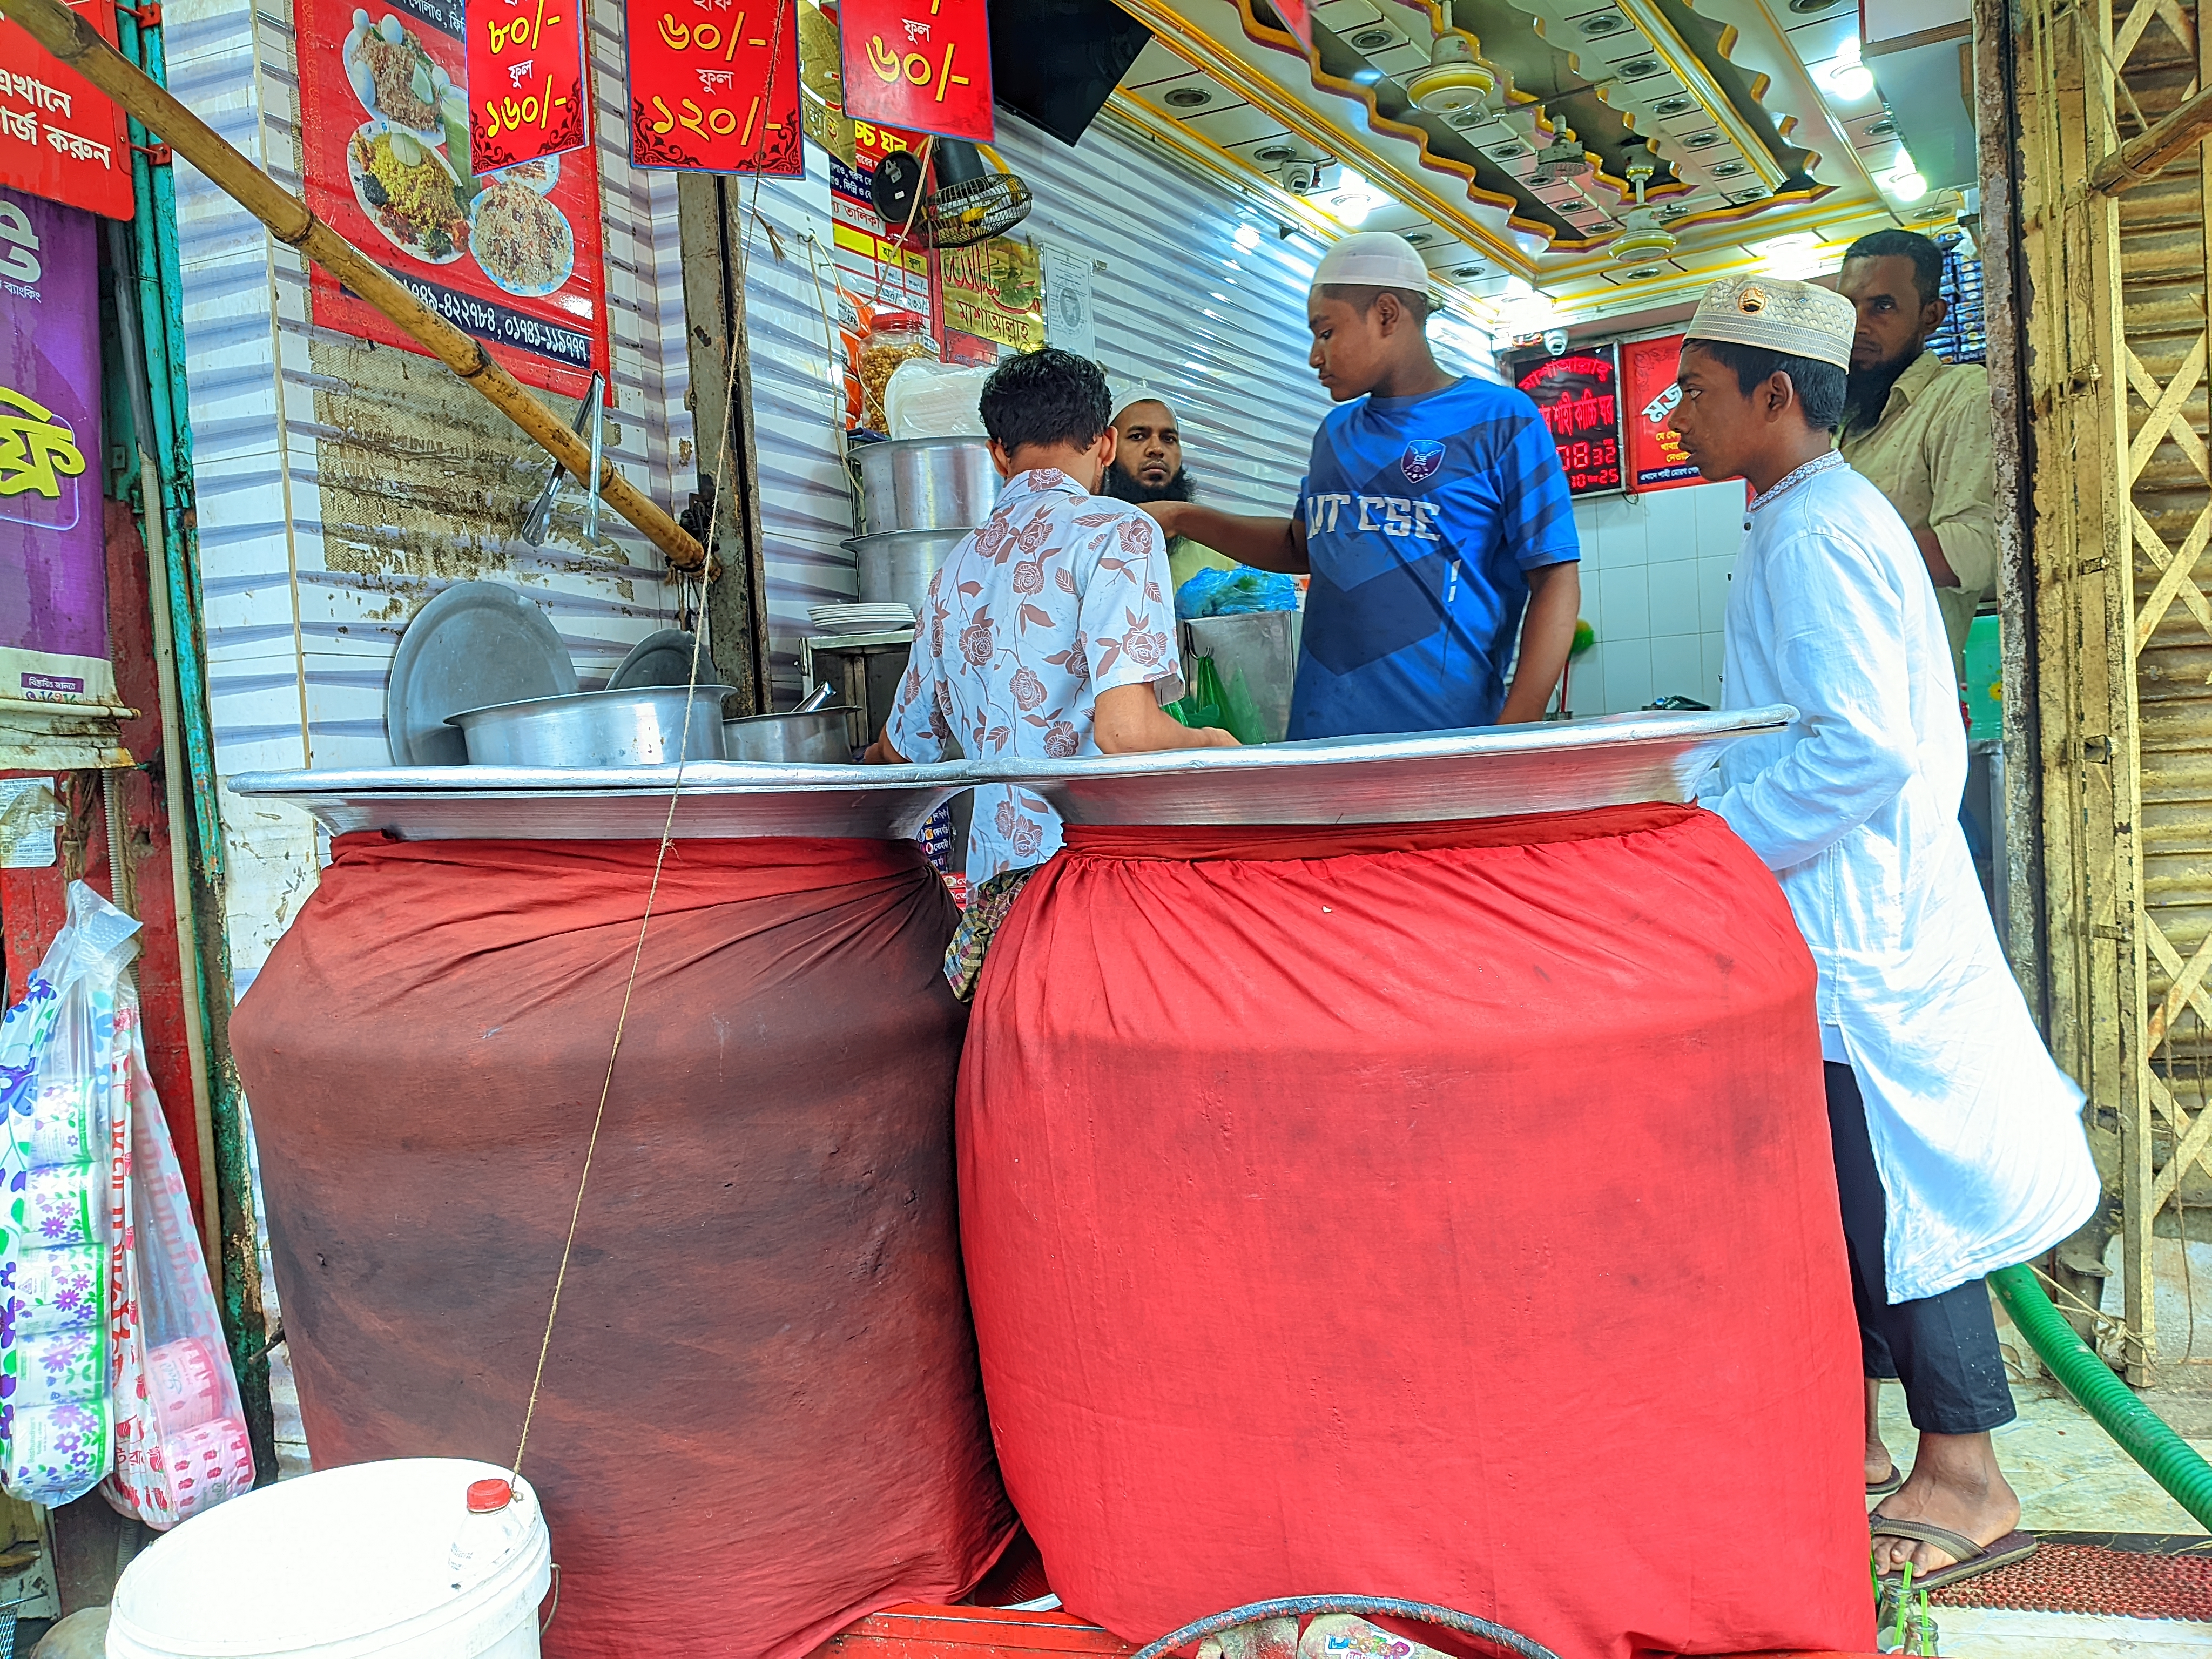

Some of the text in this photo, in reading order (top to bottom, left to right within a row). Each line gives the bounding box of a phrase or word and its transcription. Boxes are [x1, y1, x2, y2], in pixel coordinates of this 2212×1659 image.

[488, 0, 561, 54] ৮০/-
[657, 11, 766, 62] ৬০/-
[900, 18, 932, 45] ফুল
[508, 59, 534, 89] ফুল
[695, 69, 735, 96] ফুল
[865, 35, 969, 102] ৬০/-
[0, 69, 72, 118] এখানে
[486, 73, 567, 138] ১৬০/-
[0, 105, 111, 170] ার্জ করুন
[652, 96, 782, 146] ১২০/-
[843, 205, 880, 230] তালিকা
[4, 280, 42, 304] ব্যাংকিং
[1641, 381, 1683, 423] মজ
[1357, 495, 1441, 541] CSE
